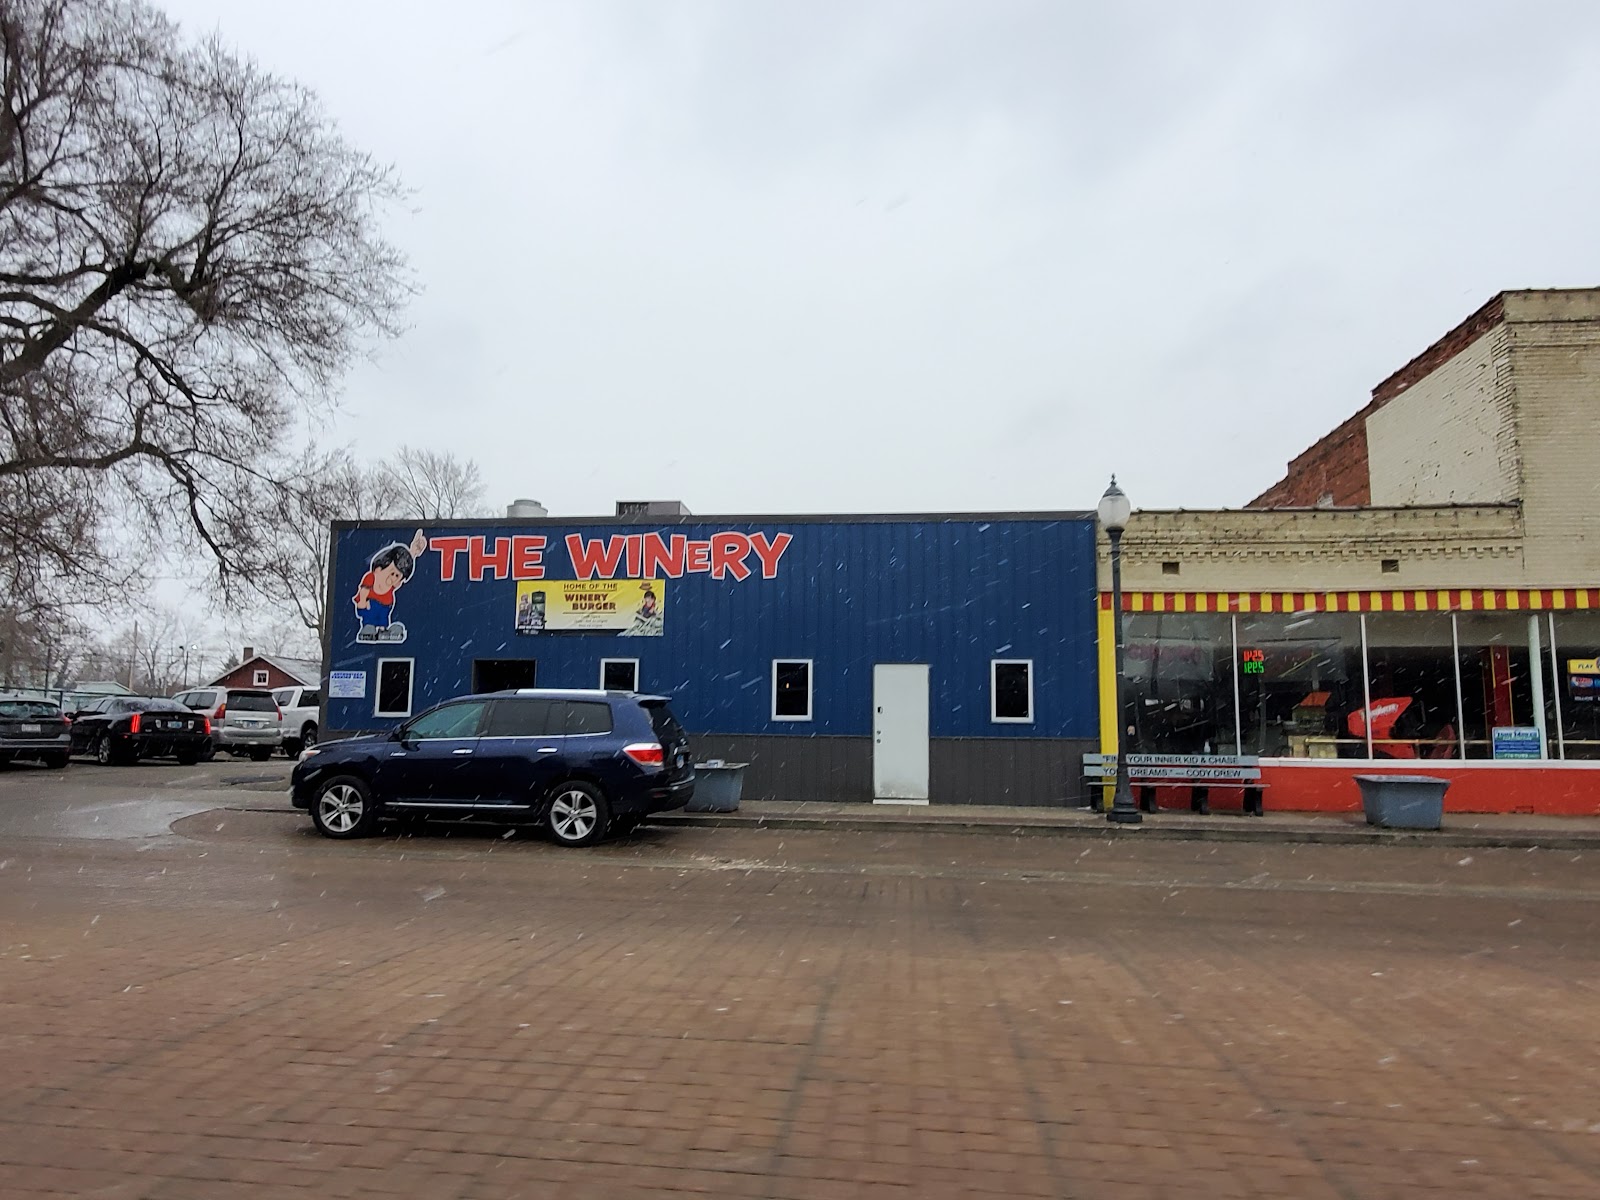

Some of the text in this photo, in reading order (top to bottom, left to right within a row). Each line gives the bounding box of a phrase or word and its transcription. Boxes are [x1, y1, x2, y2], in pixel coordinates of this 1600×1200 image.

[430, 531, 794, 582] THE WINERY
[564, 593, 609, 602] WINERY
[572, 602, 616, 611] BURGER
[1208, 756, 1238, 764] CHASE
[1186, 769, 1211, 777] CODY
[1213, 769, 1241, 777] DREW
